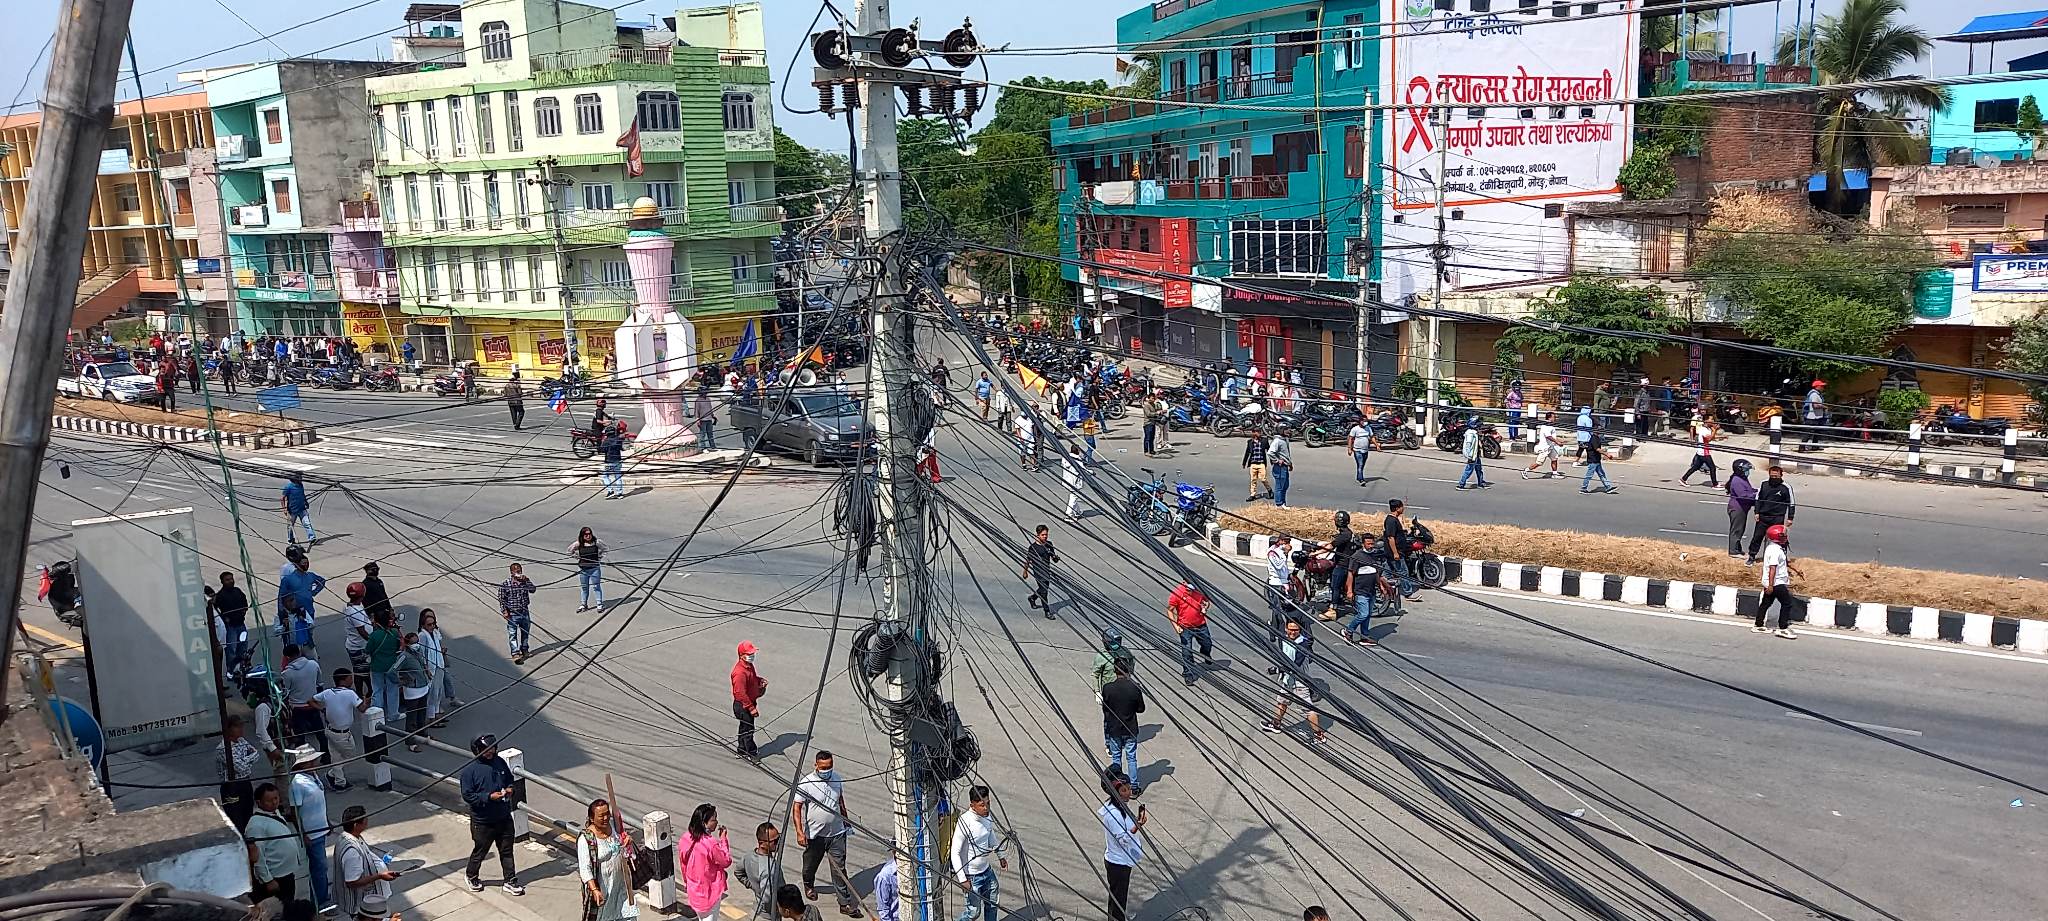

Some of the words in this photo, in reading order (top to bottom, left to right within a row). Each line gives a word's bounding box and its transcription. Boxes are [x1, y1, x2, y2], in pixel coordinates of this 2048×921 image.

[1512, 65, 1544, 103] रोग
[1486, 125, 1525, 148] उपचार
[1528, 124, 1553, 146] तथा
[1259, 324, 1277, 335] ATM
[108, 727, 130, 739] Mob.
